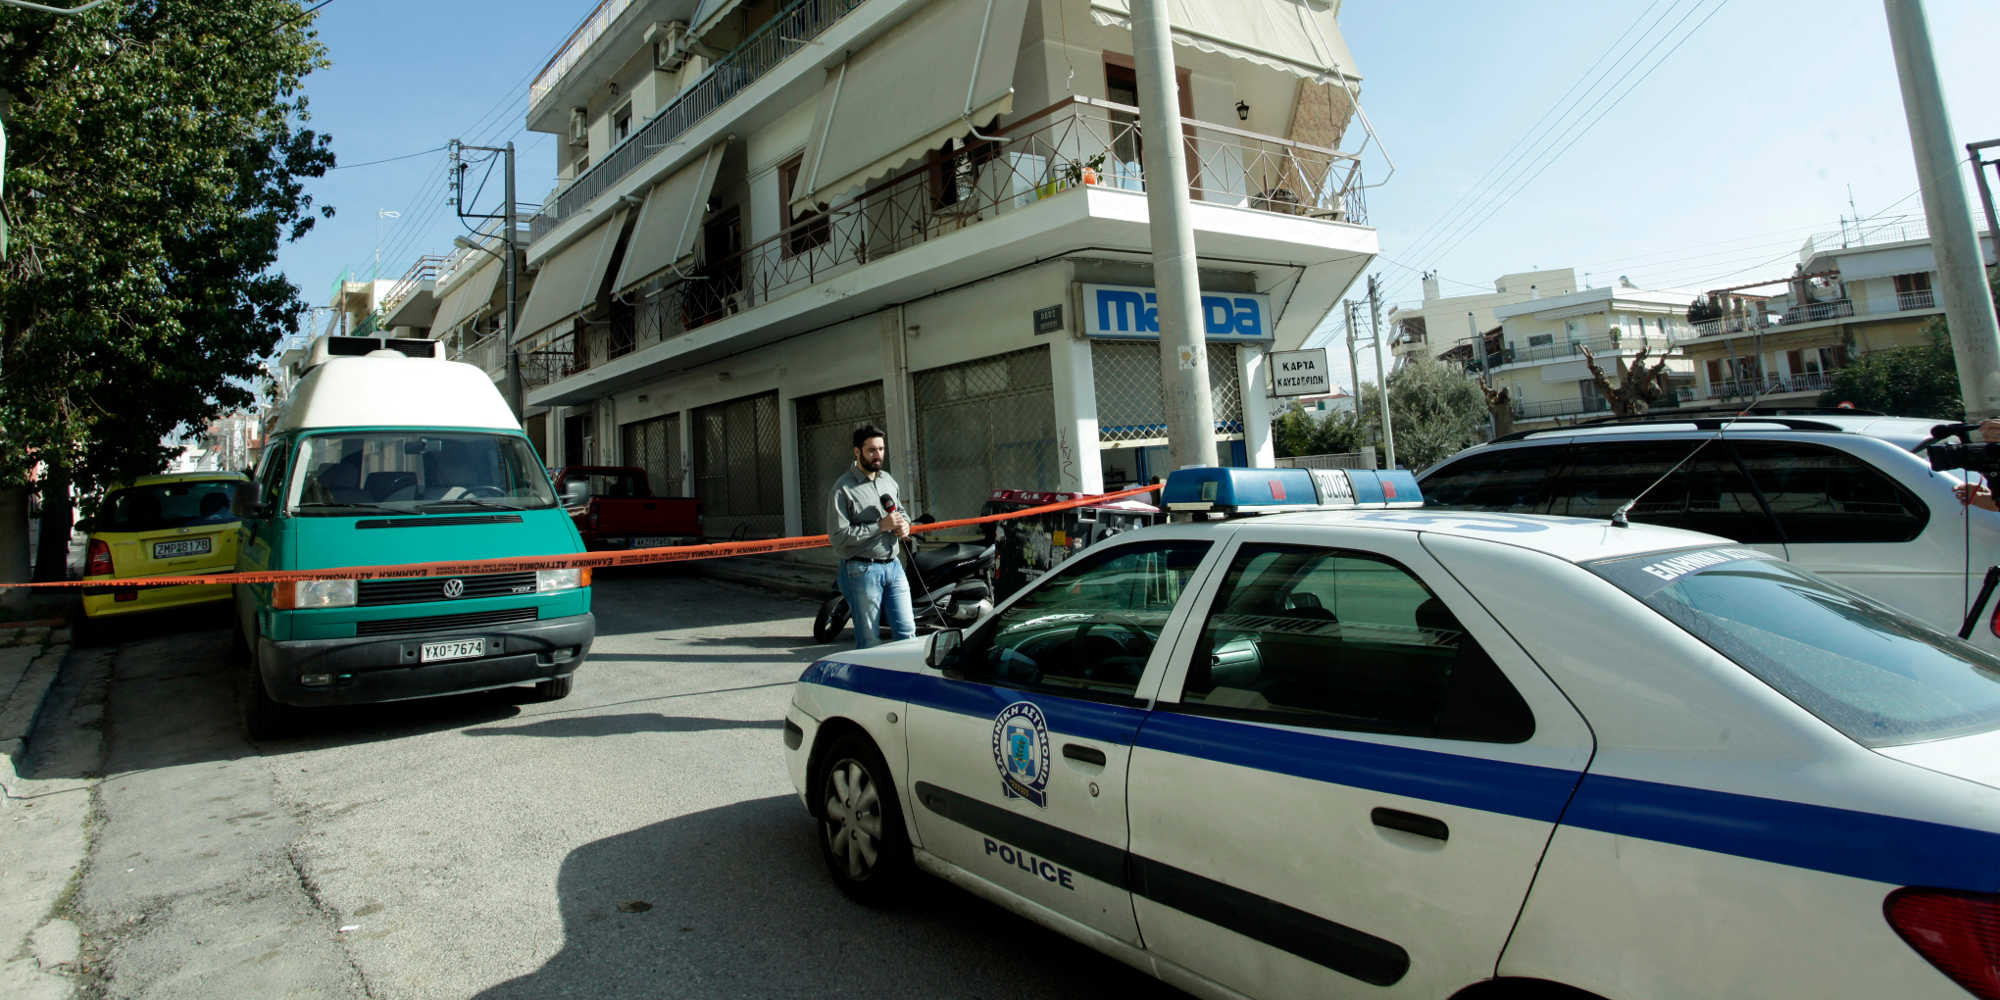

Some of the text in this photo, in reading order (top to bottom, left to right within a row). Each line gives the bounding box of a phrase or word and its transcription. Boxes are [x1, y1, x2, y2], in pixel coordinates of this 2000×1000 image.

[1097, 290, 1262, 336] mada
[1282, 360, 1315, 371] ΚΑΡΤΑ
[984, 837, 1075, 891] POLICE
